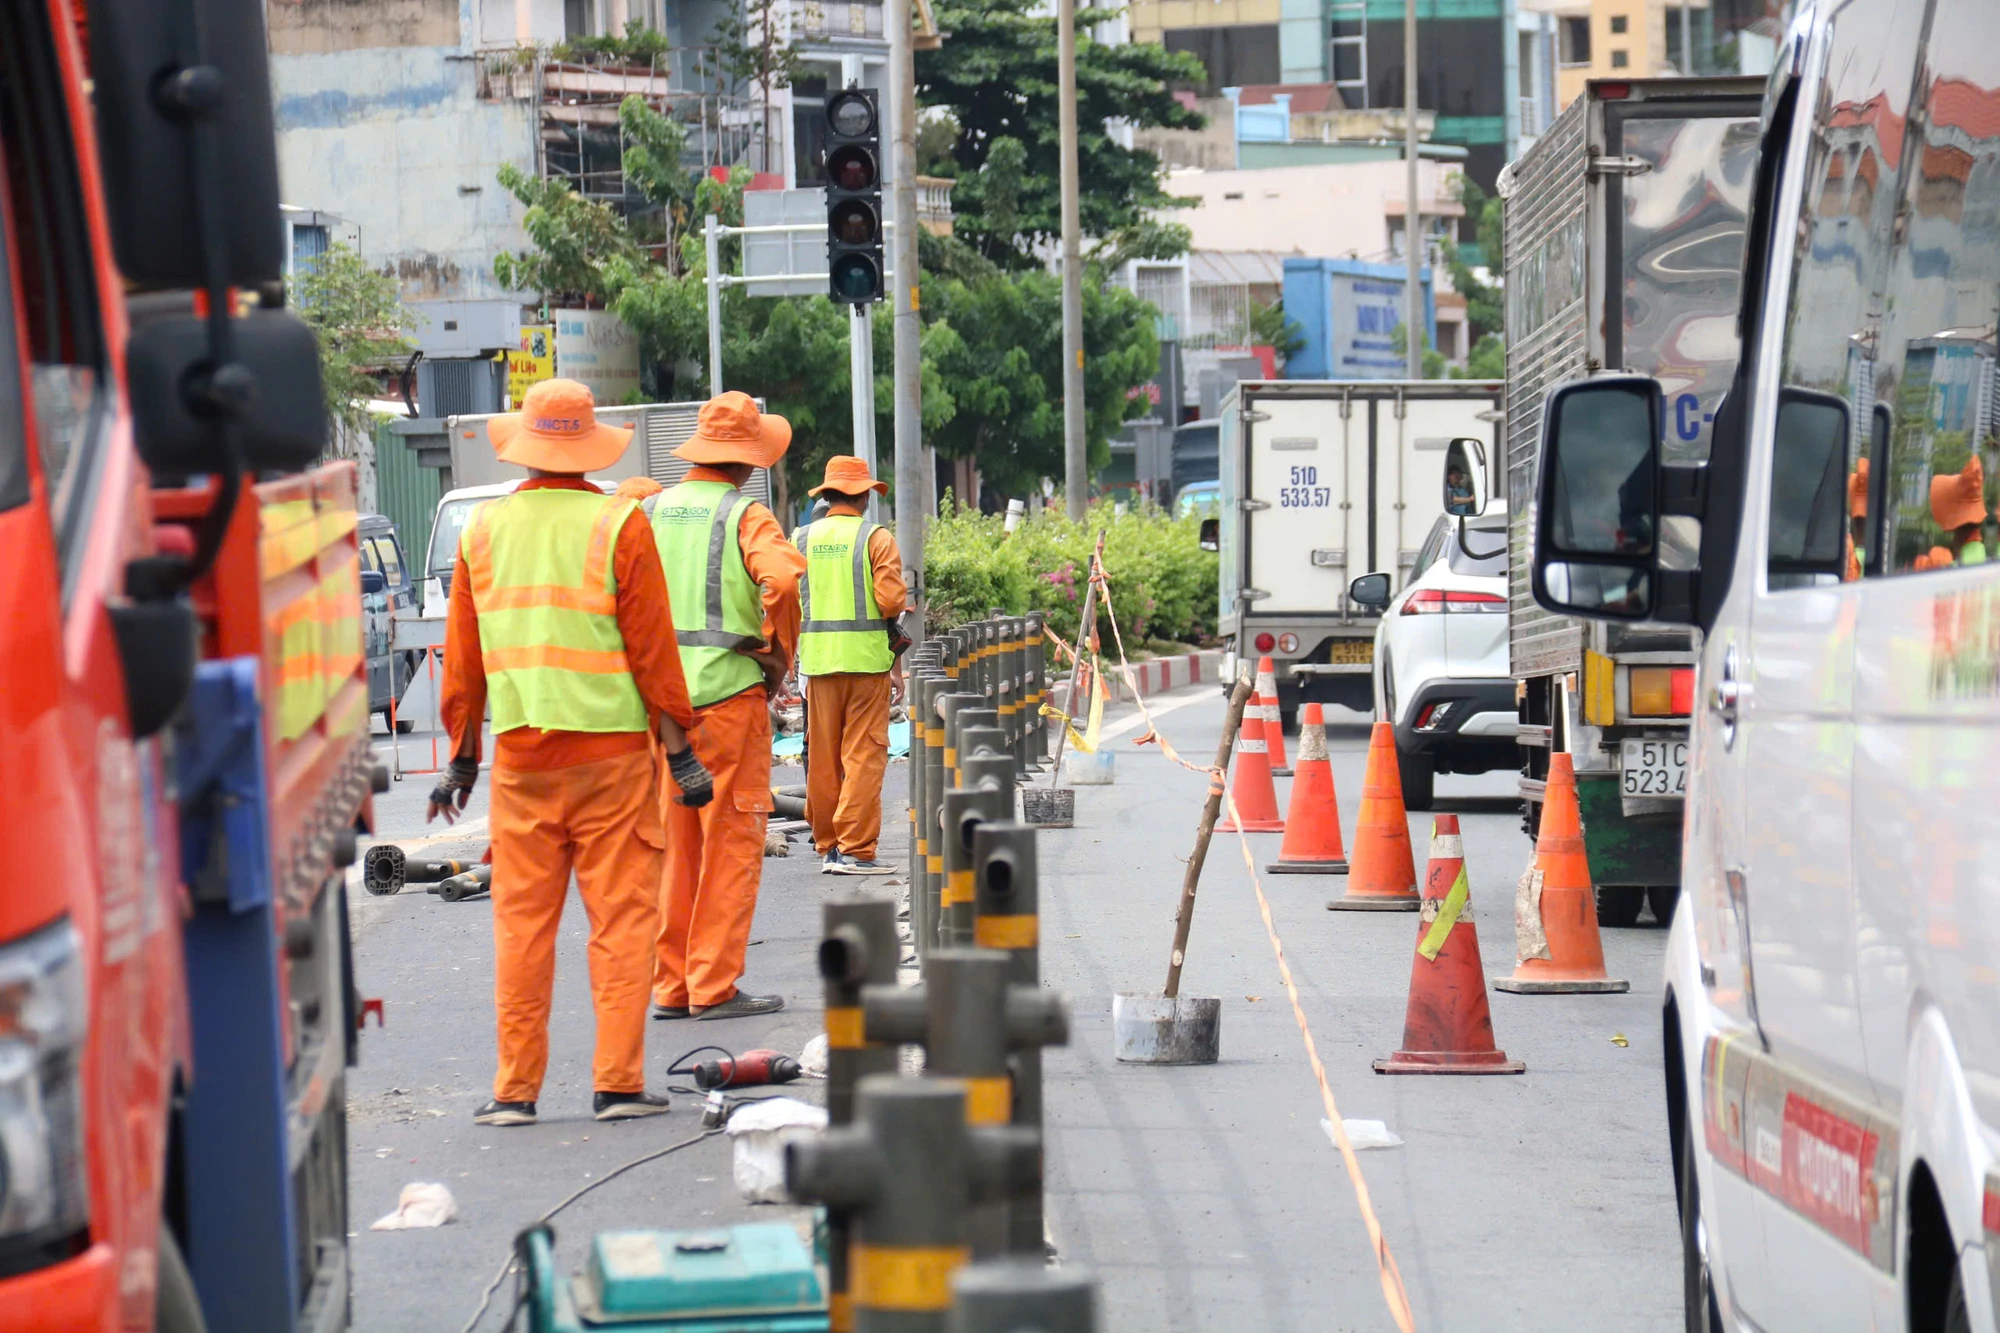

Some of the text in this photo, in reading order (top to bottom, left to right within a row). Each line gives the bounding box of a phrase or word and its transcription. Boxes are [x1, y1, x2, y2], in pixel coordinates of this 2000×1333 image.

[1291, 466, 1317, 485] 51D
[1281, 488, 1331, 508] 533.57
[1642, 742, 1688, 767] 51C
[1624, 768, 1686, 794] 523.4
